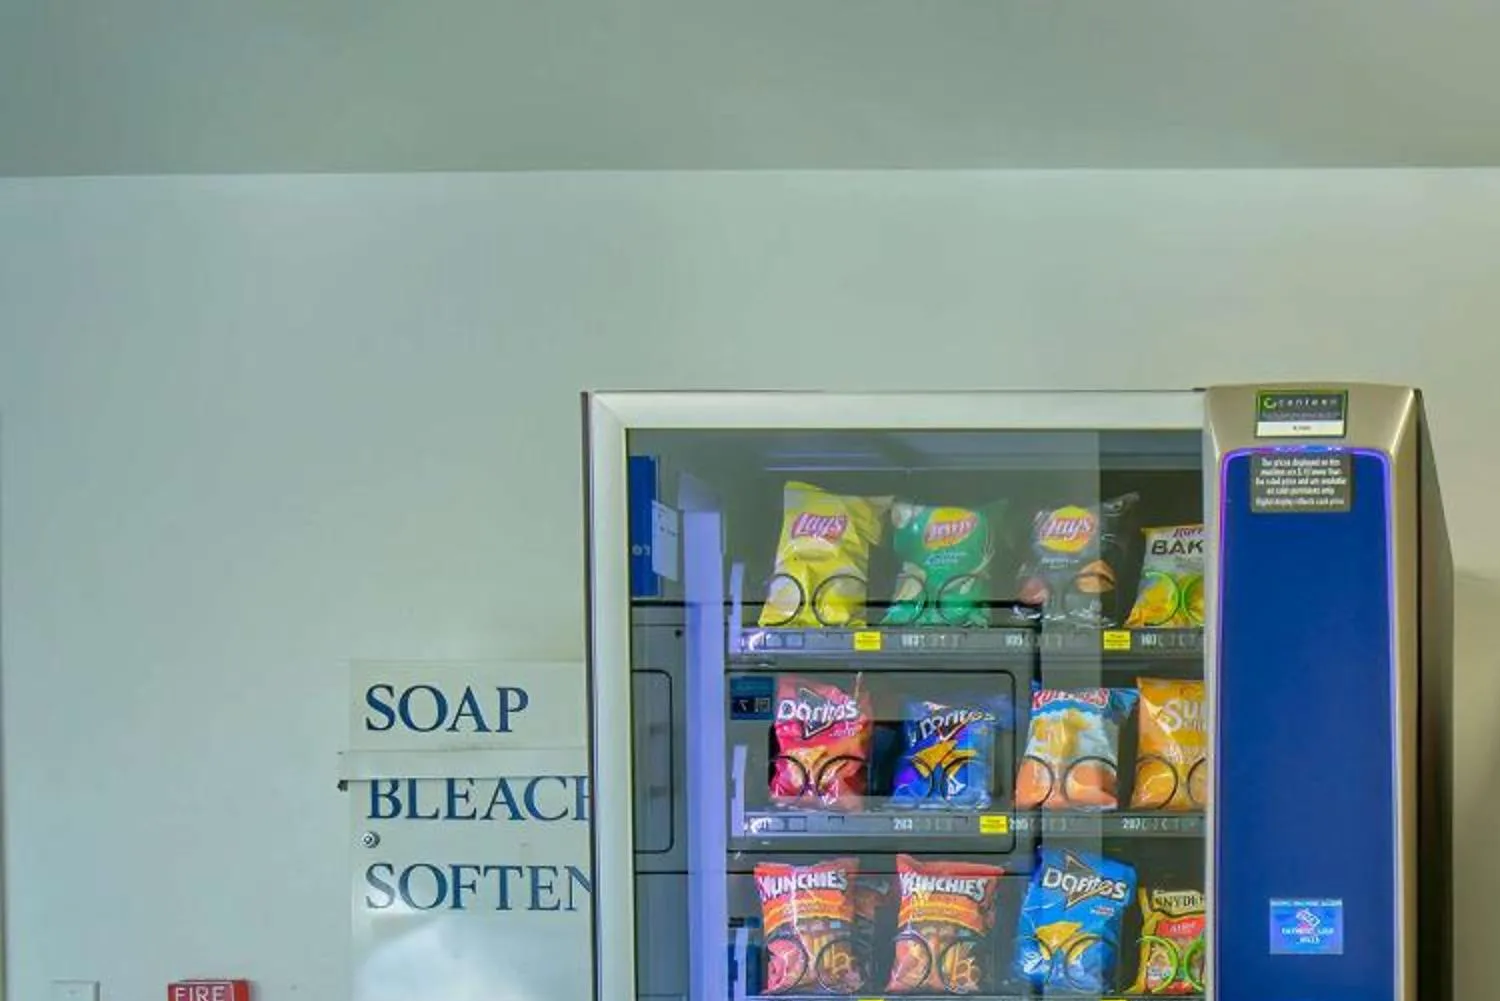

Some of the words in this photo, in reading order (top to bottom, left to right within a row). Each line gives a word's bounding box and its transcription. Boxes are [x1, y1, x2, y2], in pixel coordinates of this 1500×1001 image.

[799, 512, 847, 538] Lay's
[365, 684, 529, 733] SOAP
[777, 699, 860, 724] Doritos
[919, 708, 996, 740] Doritos
[757, 870, 848, 901] MUNCHIES
[899, 873, 988, 901] MUNCHIES
[1042, 867, 1128, 899] Doritos
